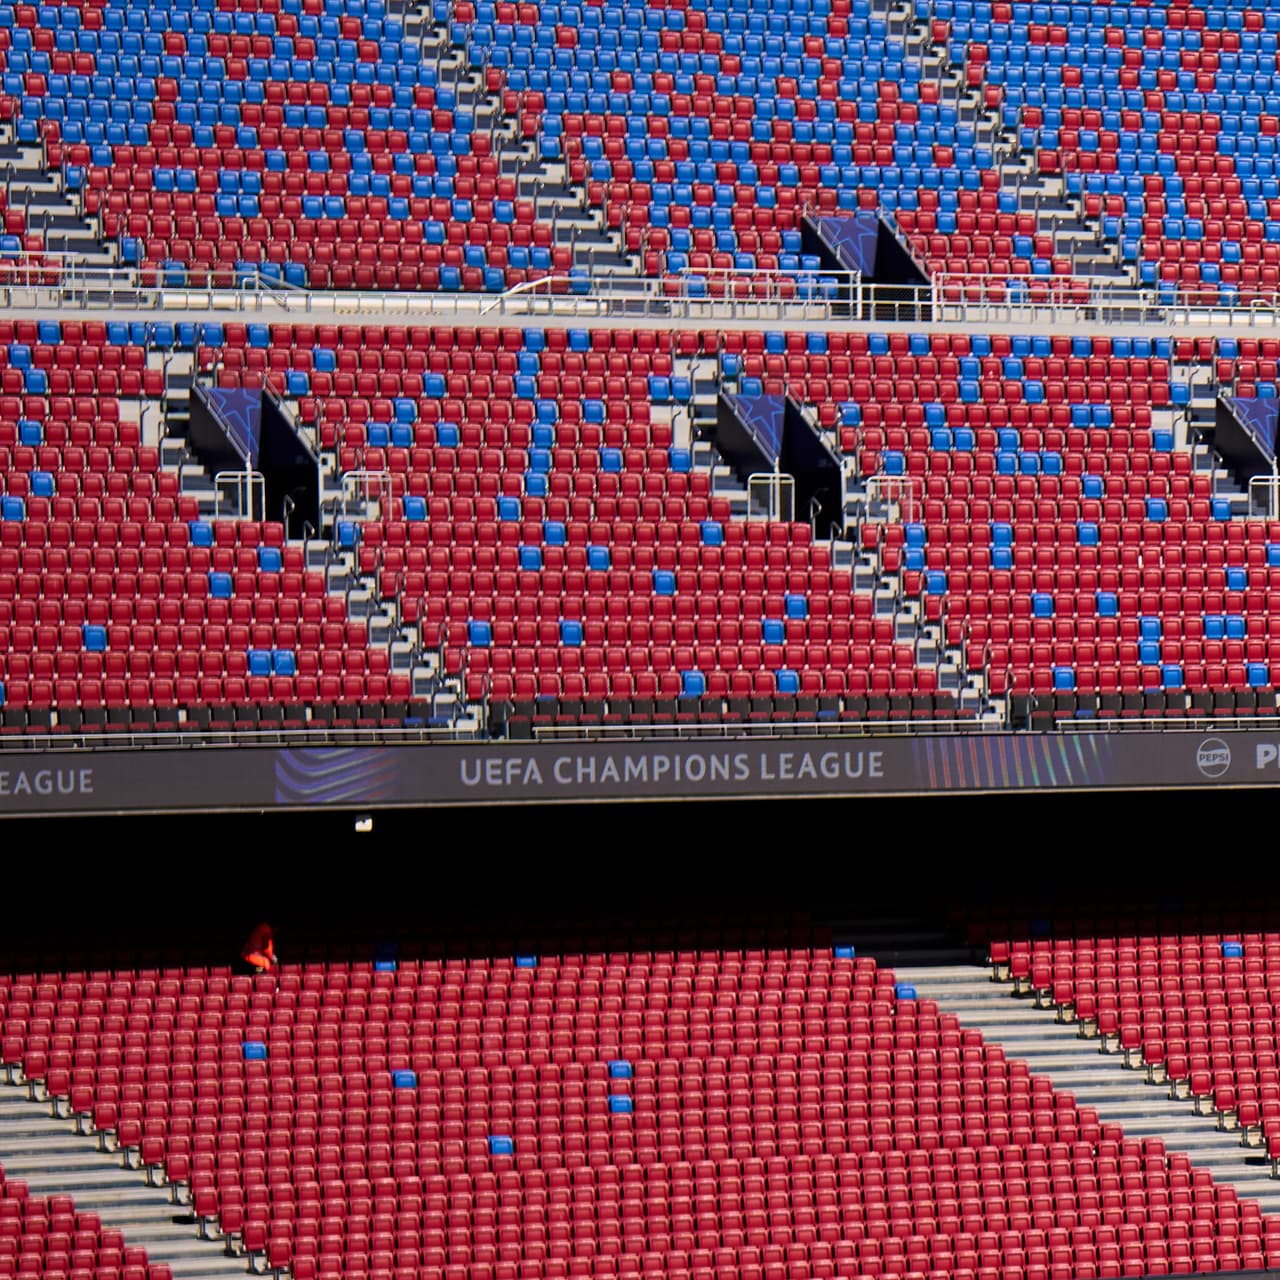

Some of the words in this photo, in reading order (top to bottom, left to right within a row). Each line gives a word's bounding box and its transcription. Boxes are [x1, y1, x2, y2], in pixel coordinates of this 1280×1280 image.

[460, 758, 543, 785] UEFA
[553, 753, 750, 784] CHAMPIONS
[760, 751, 884, 780] LEAGUE
[1200, 752, 1229, 762] PEPSI
